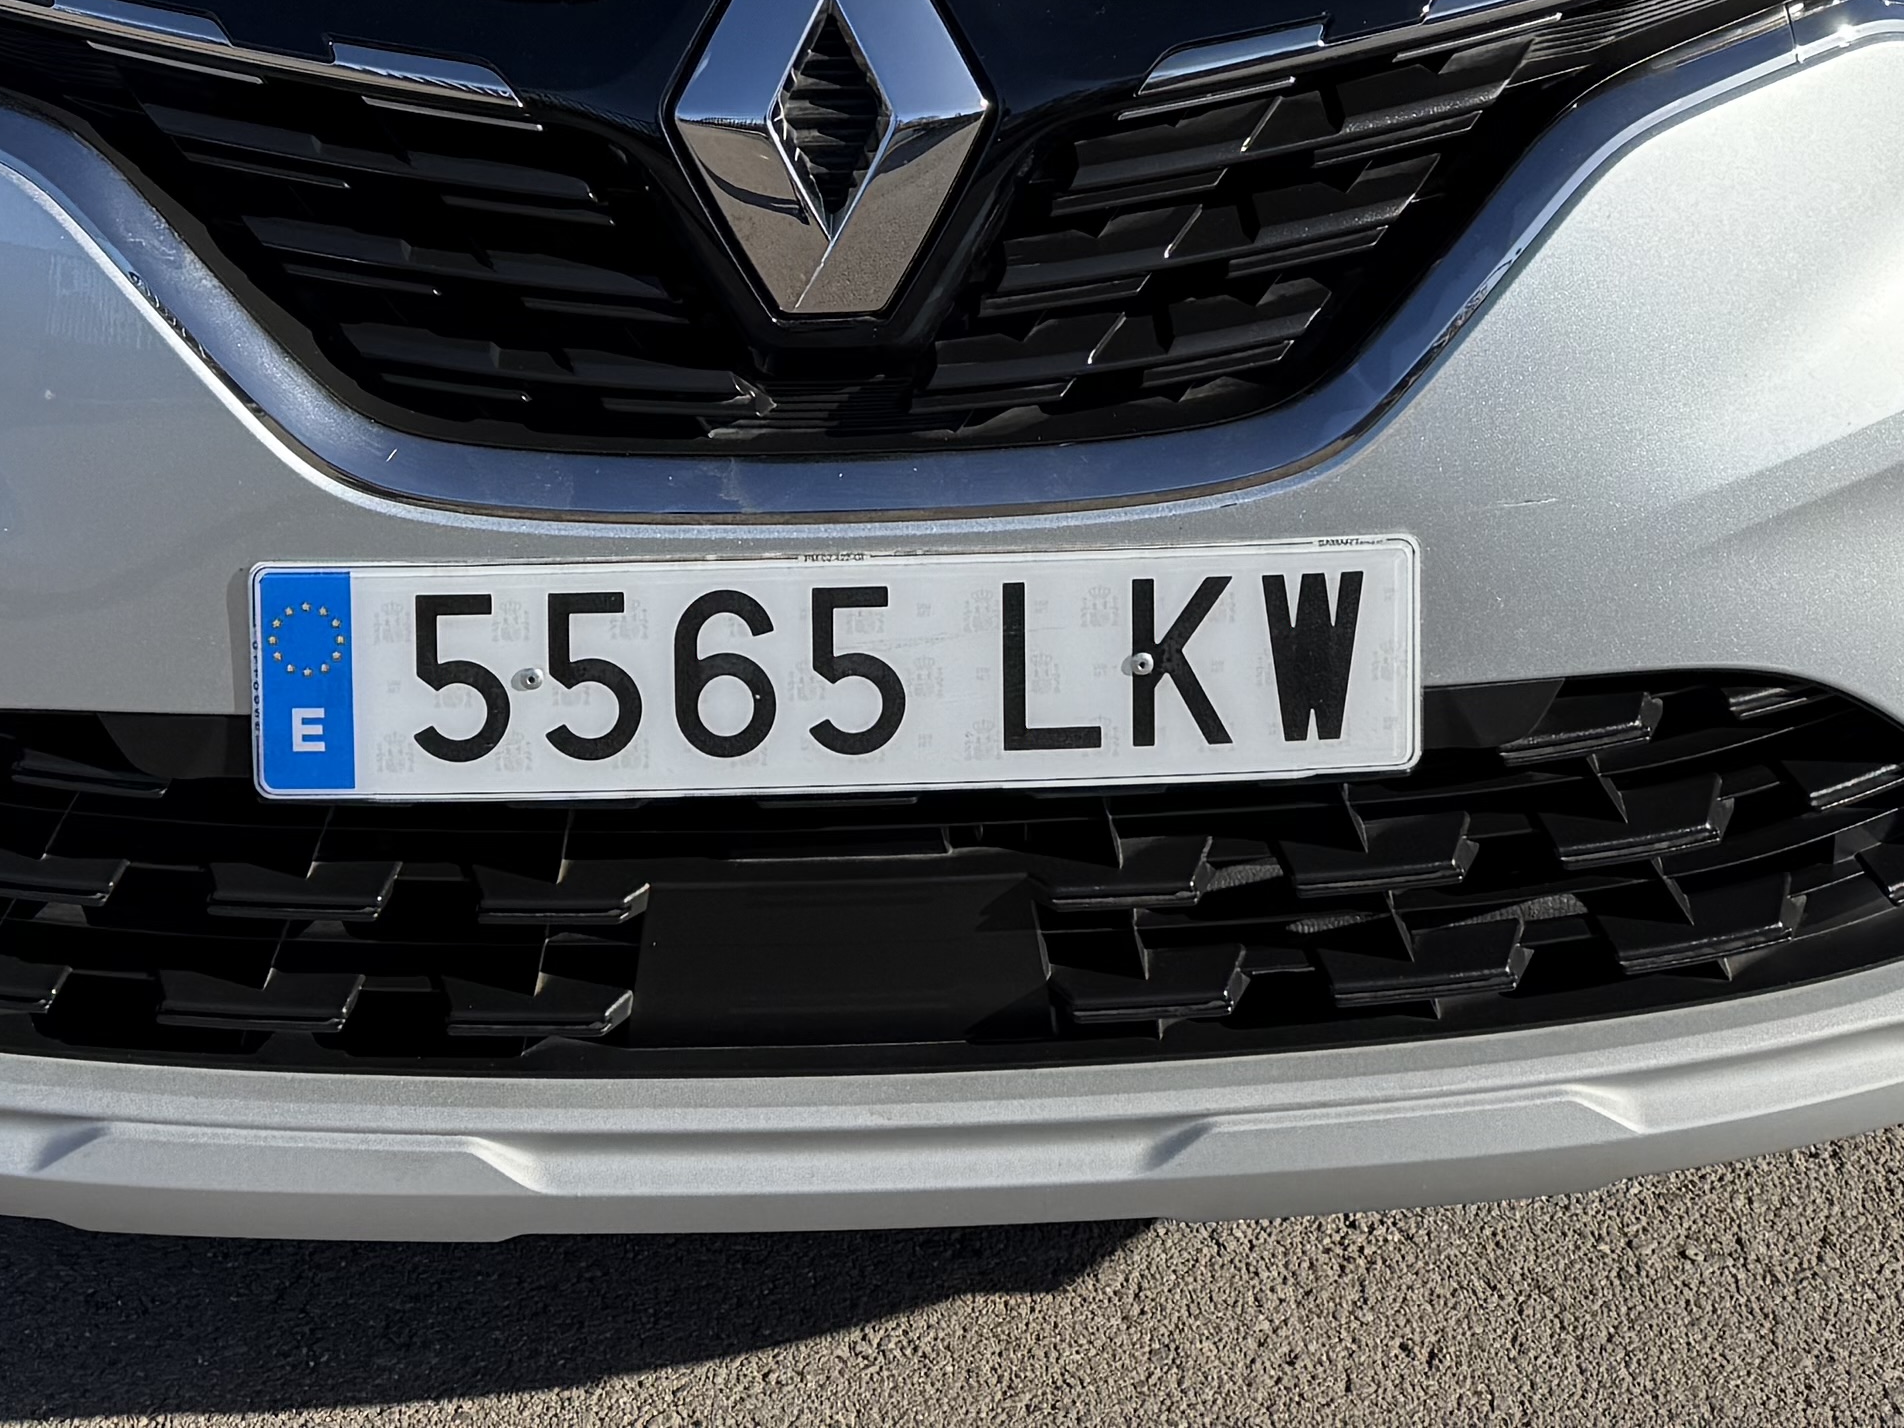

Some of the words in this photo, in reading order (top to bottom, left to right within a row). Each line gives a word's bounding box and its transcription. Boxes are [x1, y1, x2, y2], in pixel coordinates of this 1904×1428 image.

[291, 707, 326, 752] E
[412, 586, 906, 762] 5565
[1001, 570, 1365, 752] LKW
